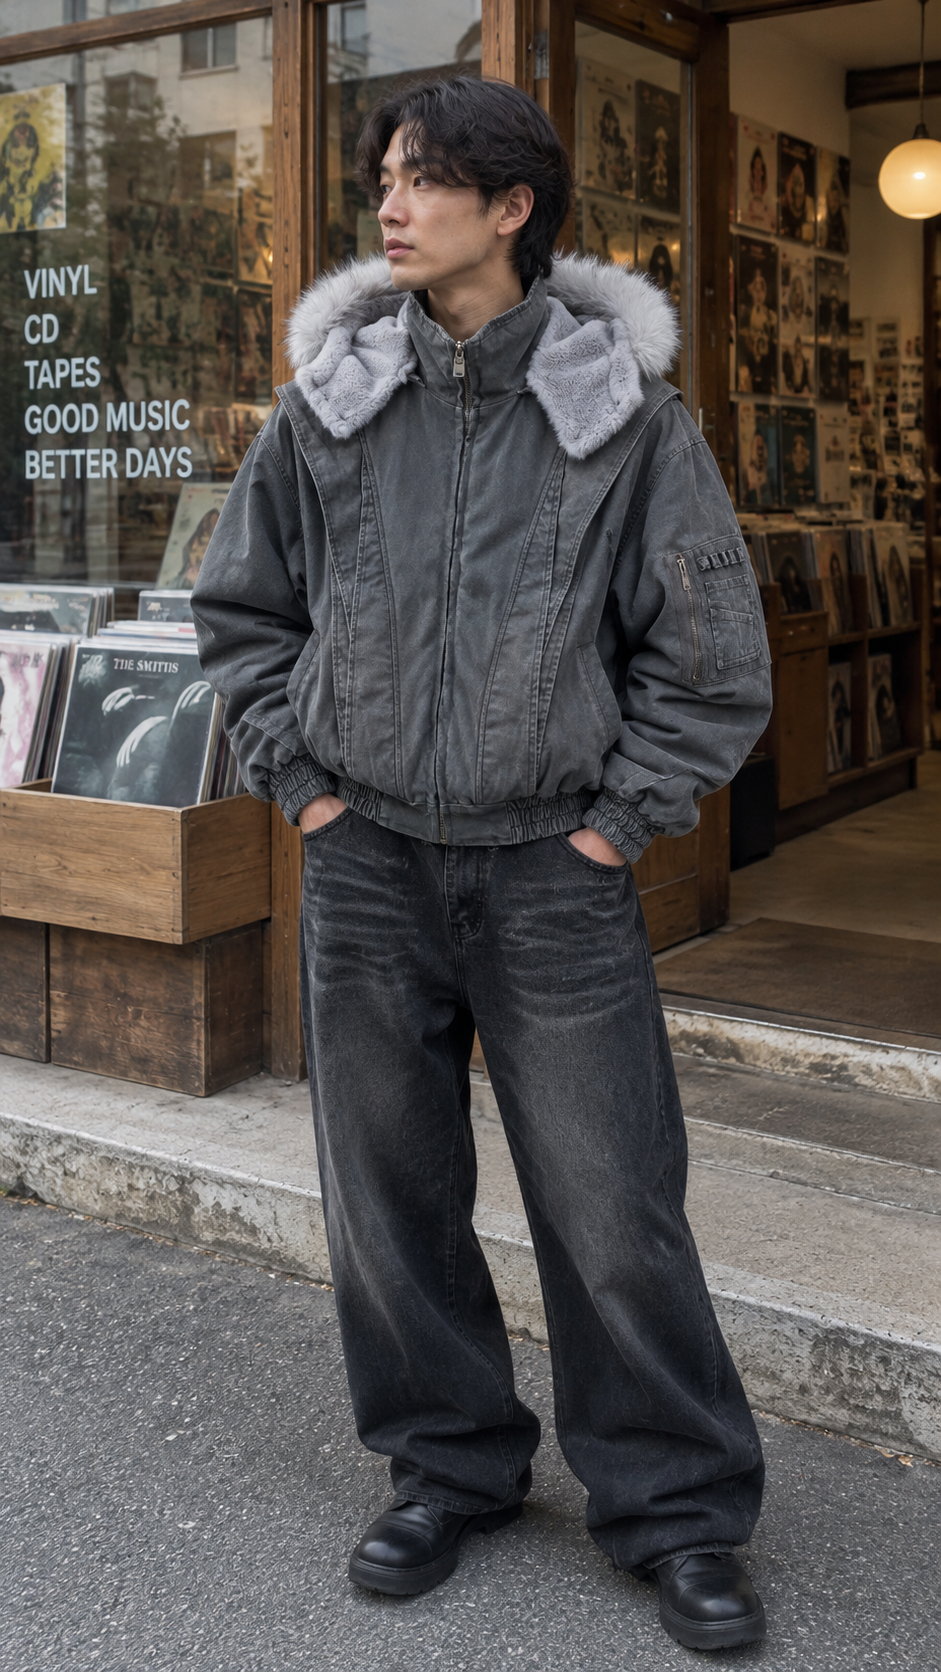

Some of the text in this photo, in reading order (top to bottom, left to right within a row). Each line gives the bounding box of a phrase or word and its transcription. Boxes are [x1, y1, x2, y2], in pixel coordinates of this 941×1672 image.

[23, 264, 98, 299] VINYL
[24, 313, 60, 345] CD
[24, 356, 101, 390] TAPES
[24, 398, 191, 435] GOOD MUSIC
[25, 446, 193, 480] BETTER DAYS
